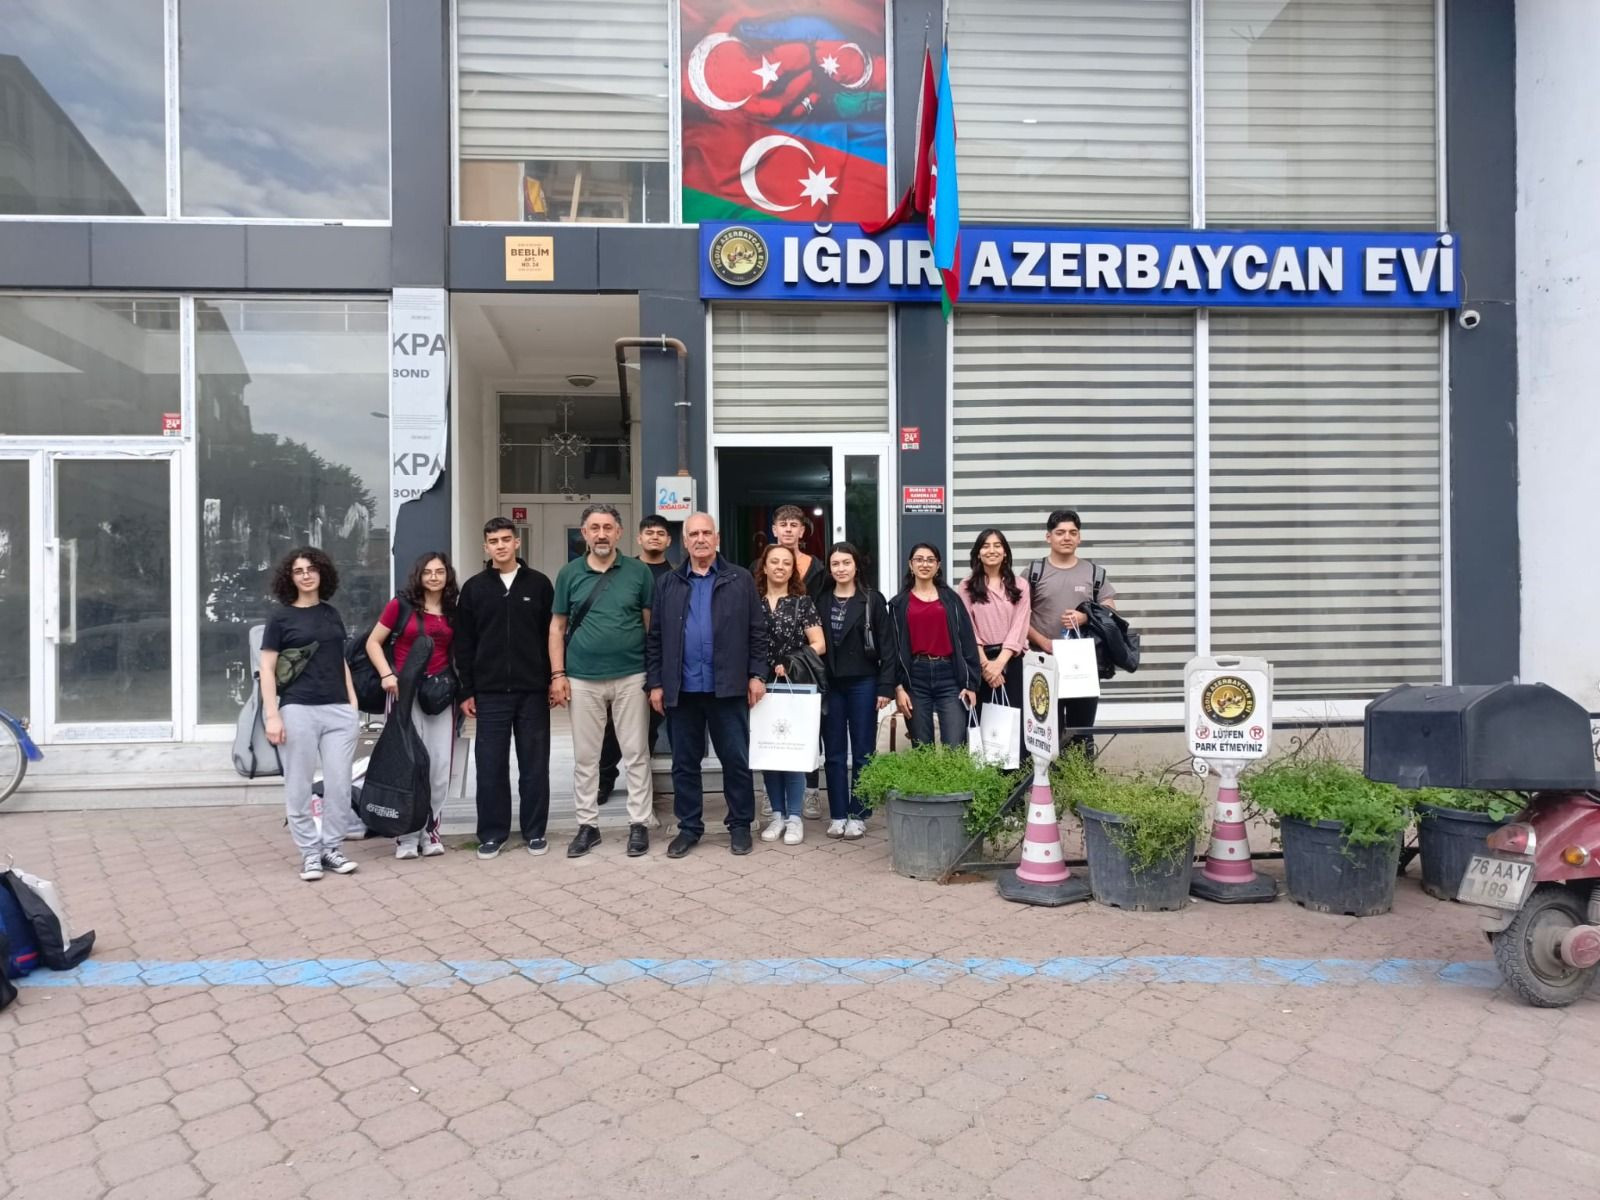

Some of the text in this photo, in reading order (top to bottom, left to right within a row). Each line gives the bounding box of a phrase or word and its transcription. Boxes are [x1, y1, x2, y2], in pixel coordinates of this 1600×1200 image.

[720, 231, 763, 253] AZERBAYCAN
[784, 223, 1453, 292] IĞDIR AZERBAYCAN EVİ
[392, 368, 430, 378] BOND
[393, 488, 427, 498] BON
[1209, 678, 1252, 699] AZERBAYCAN
[1213, 728, 1244, 739] LÜTFEN
[1195, 743, 1217, 751] PARK
[1471, 858, 1528, 881] 76 AAY
[1481, 880, 1508, 898] 189
